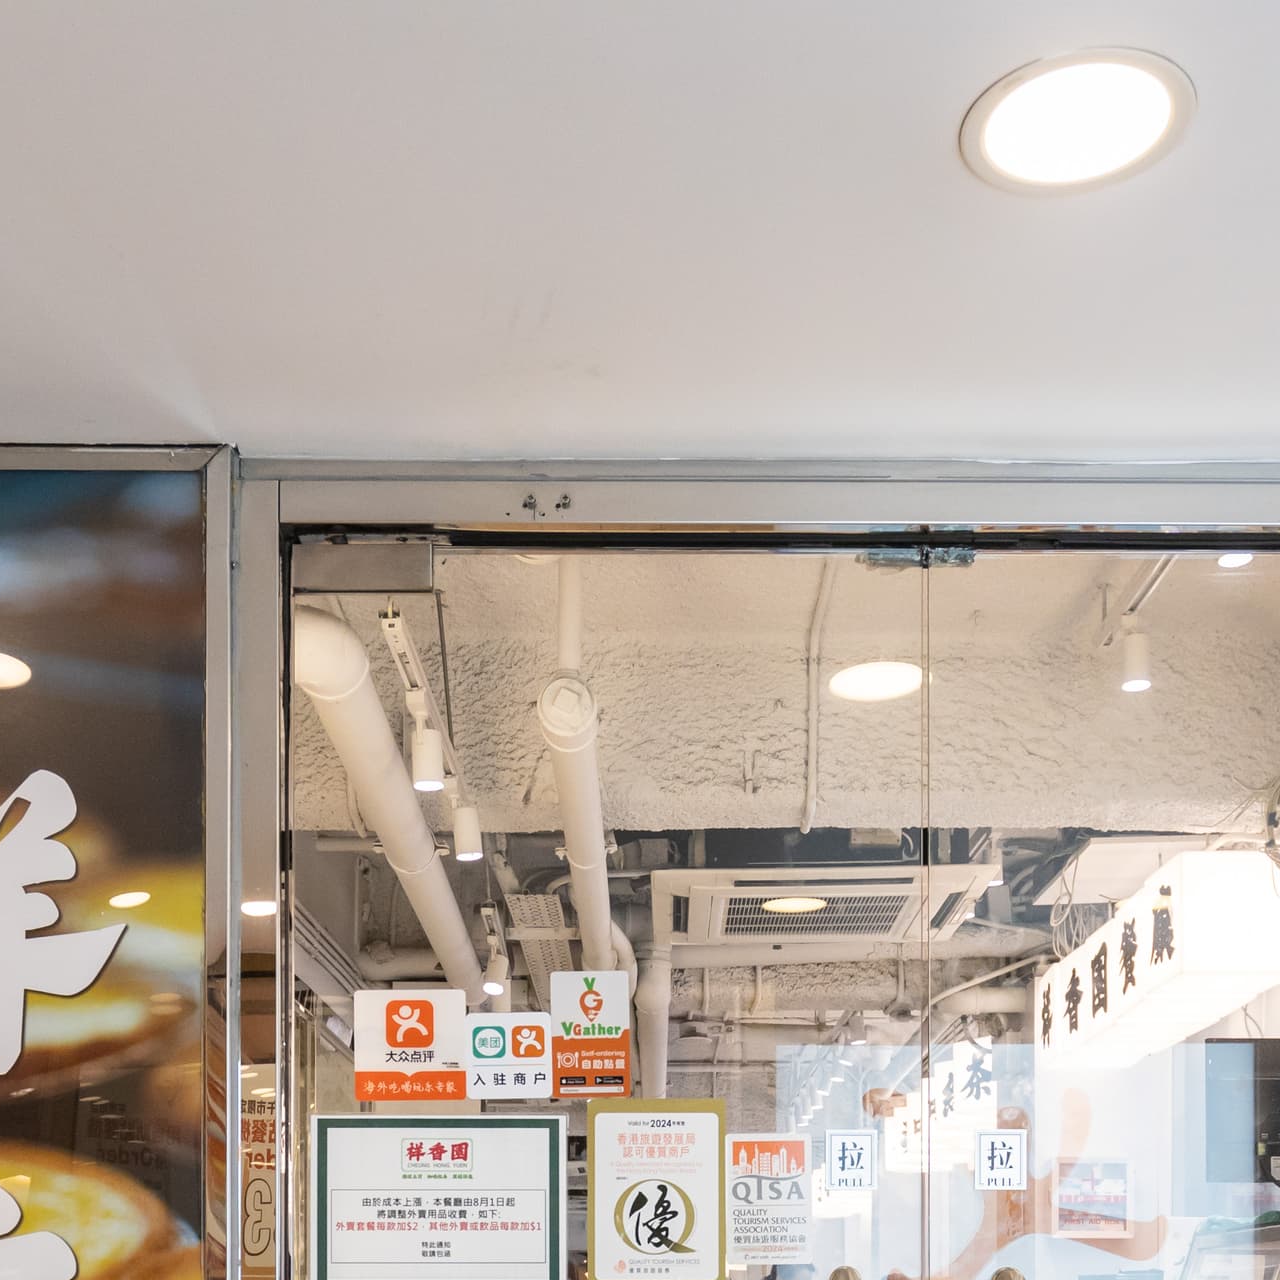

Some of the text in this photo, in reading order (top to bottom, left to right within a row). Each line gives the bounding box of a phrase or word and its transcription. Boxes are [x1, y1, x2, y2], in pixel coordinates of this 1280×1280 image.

[561, 1021, 621, 1037] VGather
[477, 1036, 501, 1049] 美团
[385, 1050, 435, 1063] 大众点评
[473, 1072, 547, 1086] 入驻商户
[650, 1119, 672, 1128] 2024
[406, 1142, 469, 1162] 祥香園
[837, 1141, 865, 1172] 拉
[987, 1141, 1014, 1171] 拉
[838, 1178, 865, 1187] PULL
[987, 1177, 1014, 1186] PULL
[732, 1175, 805, 1204] QTSA
[733, 1208, 768, 1217] QUALITY
[733, 1216, 807, 1225] TOURISM SERVICES
[733, 1225, 789, 1234] ASSOCIATION
